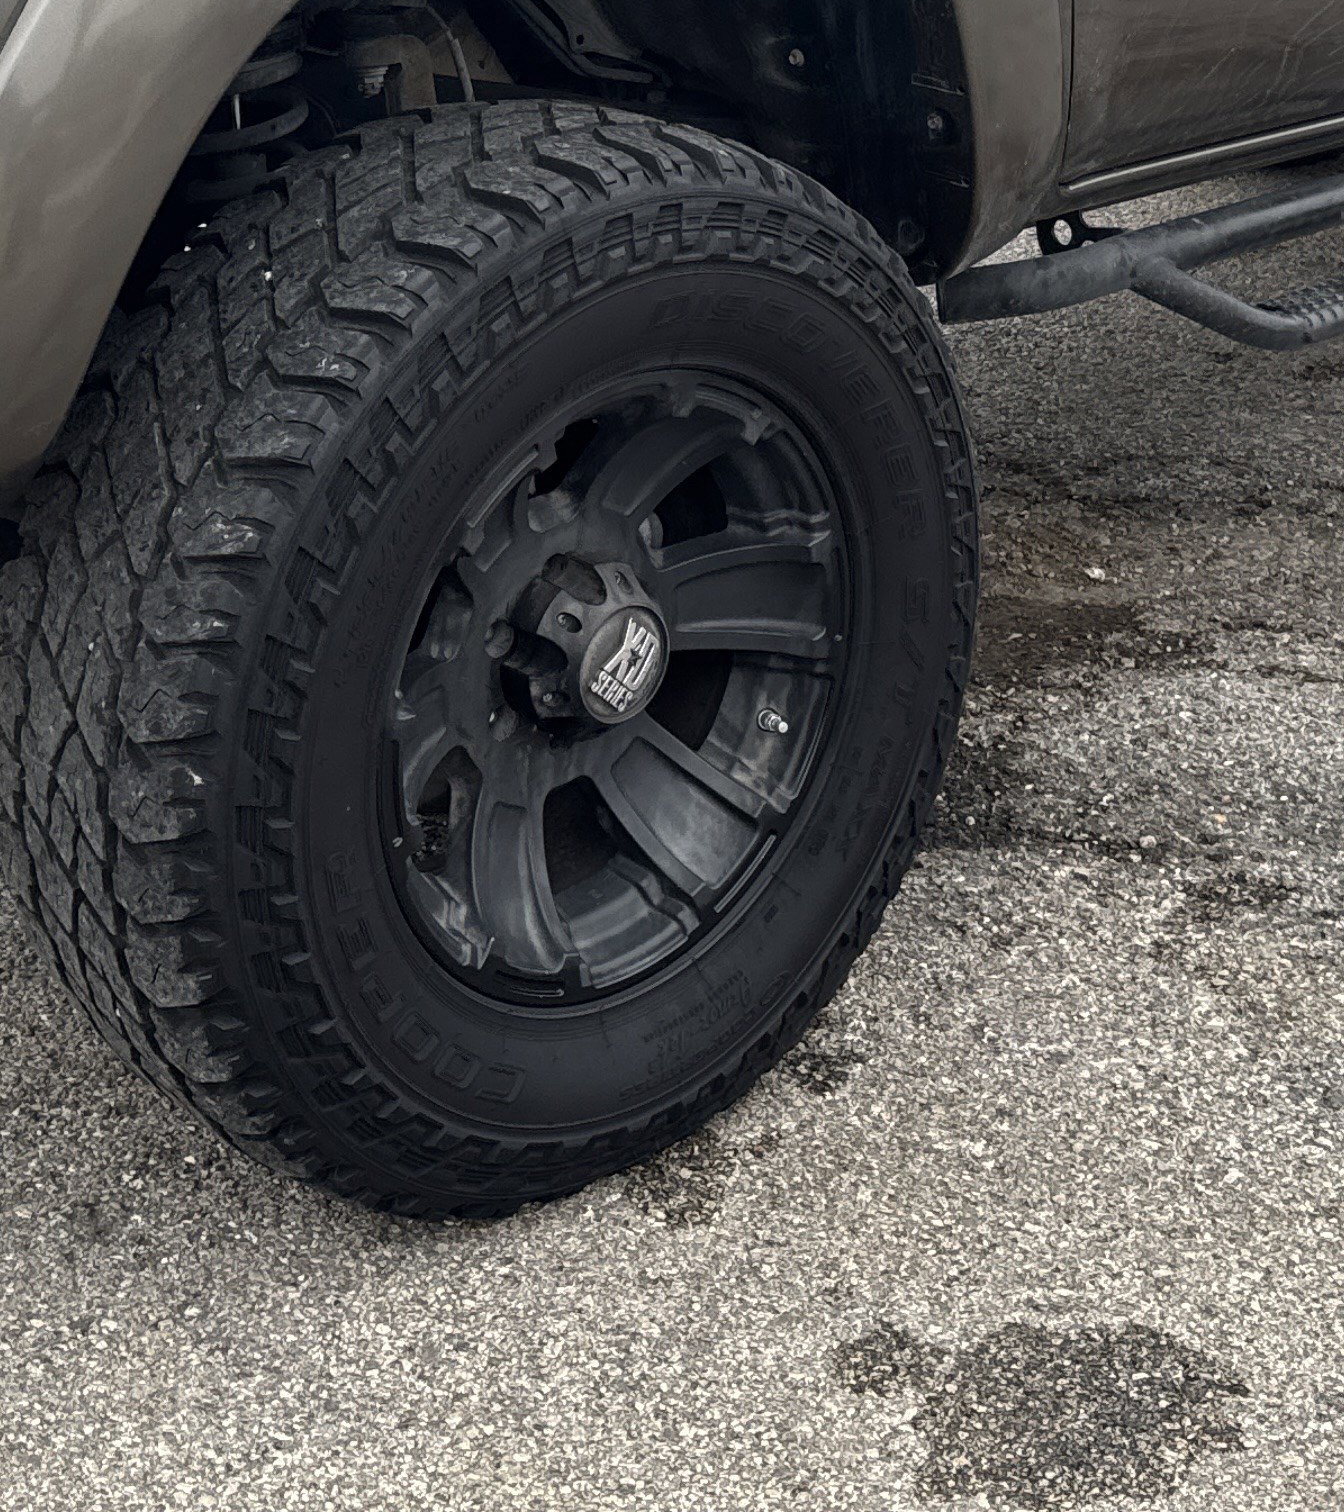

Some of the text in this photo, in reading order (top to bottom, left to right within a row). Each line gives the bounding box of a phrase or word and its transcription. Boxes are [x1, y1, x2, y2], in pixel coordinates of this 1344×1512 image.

[603, 616, 660, 691] XD
[590, 670, 634, 713] SERIES
[327, 849, 526, 1104] COOPER
